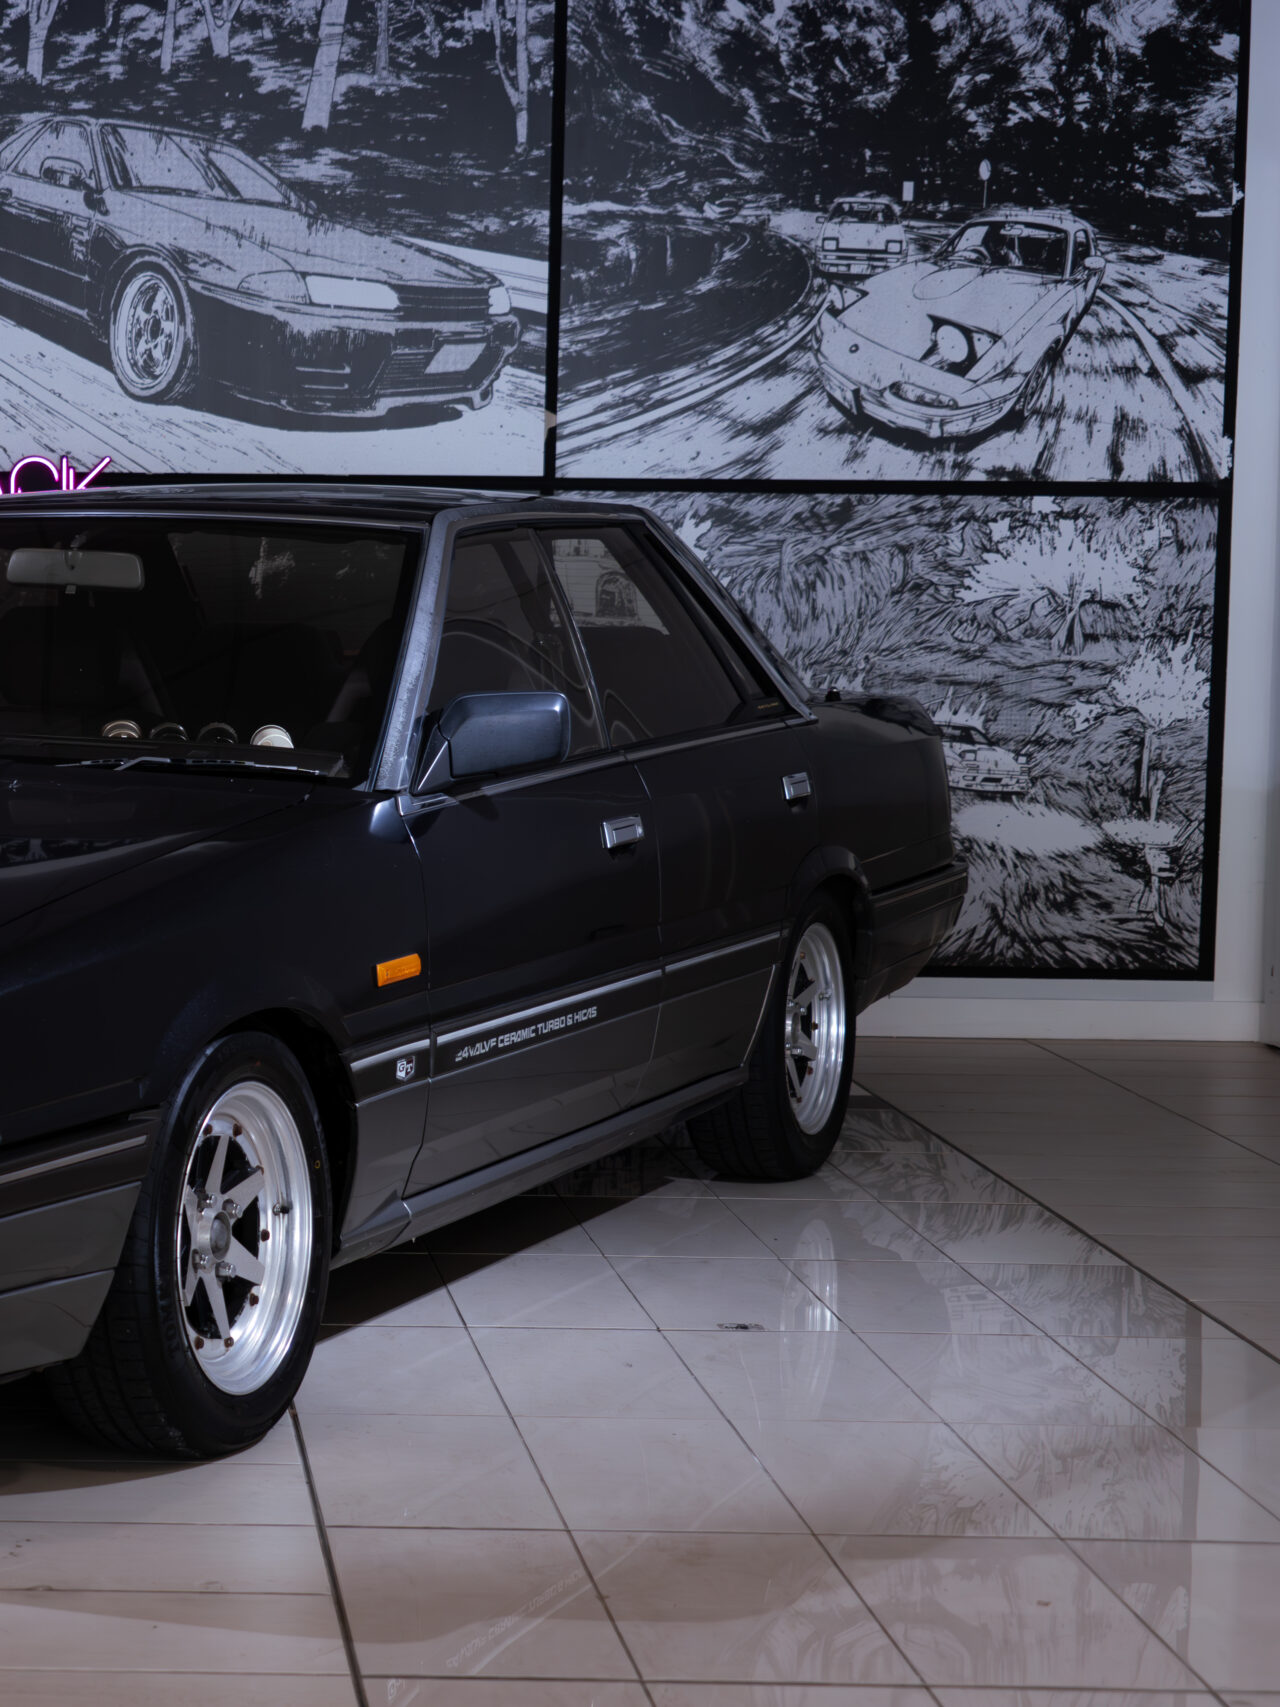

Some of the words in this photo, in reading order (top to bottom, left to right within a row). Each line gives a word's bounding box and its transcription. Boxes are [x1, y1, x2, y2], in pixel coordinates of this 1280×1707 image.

[498, 1025, 537, 1048] CERAMIC
[537, 1015, 566, 1035] TURBO
[574, 1006, 598, 1023] HICAS
